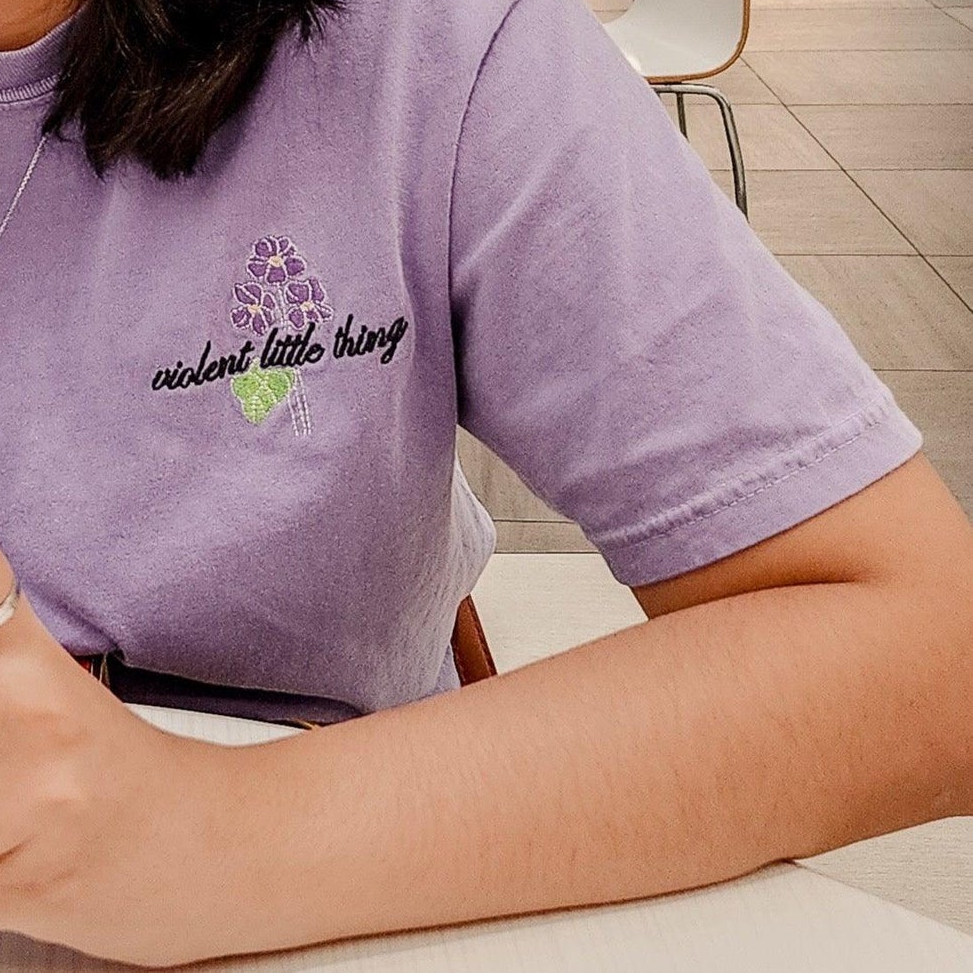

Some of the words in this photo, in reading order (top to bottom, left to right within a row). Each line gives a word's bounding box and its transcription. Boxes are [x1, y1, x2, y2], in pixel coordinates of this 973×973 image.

[151, 340, 255, 391] violent
[259, 321, 325, 369] little
[332, 313, 409, 364] thing
